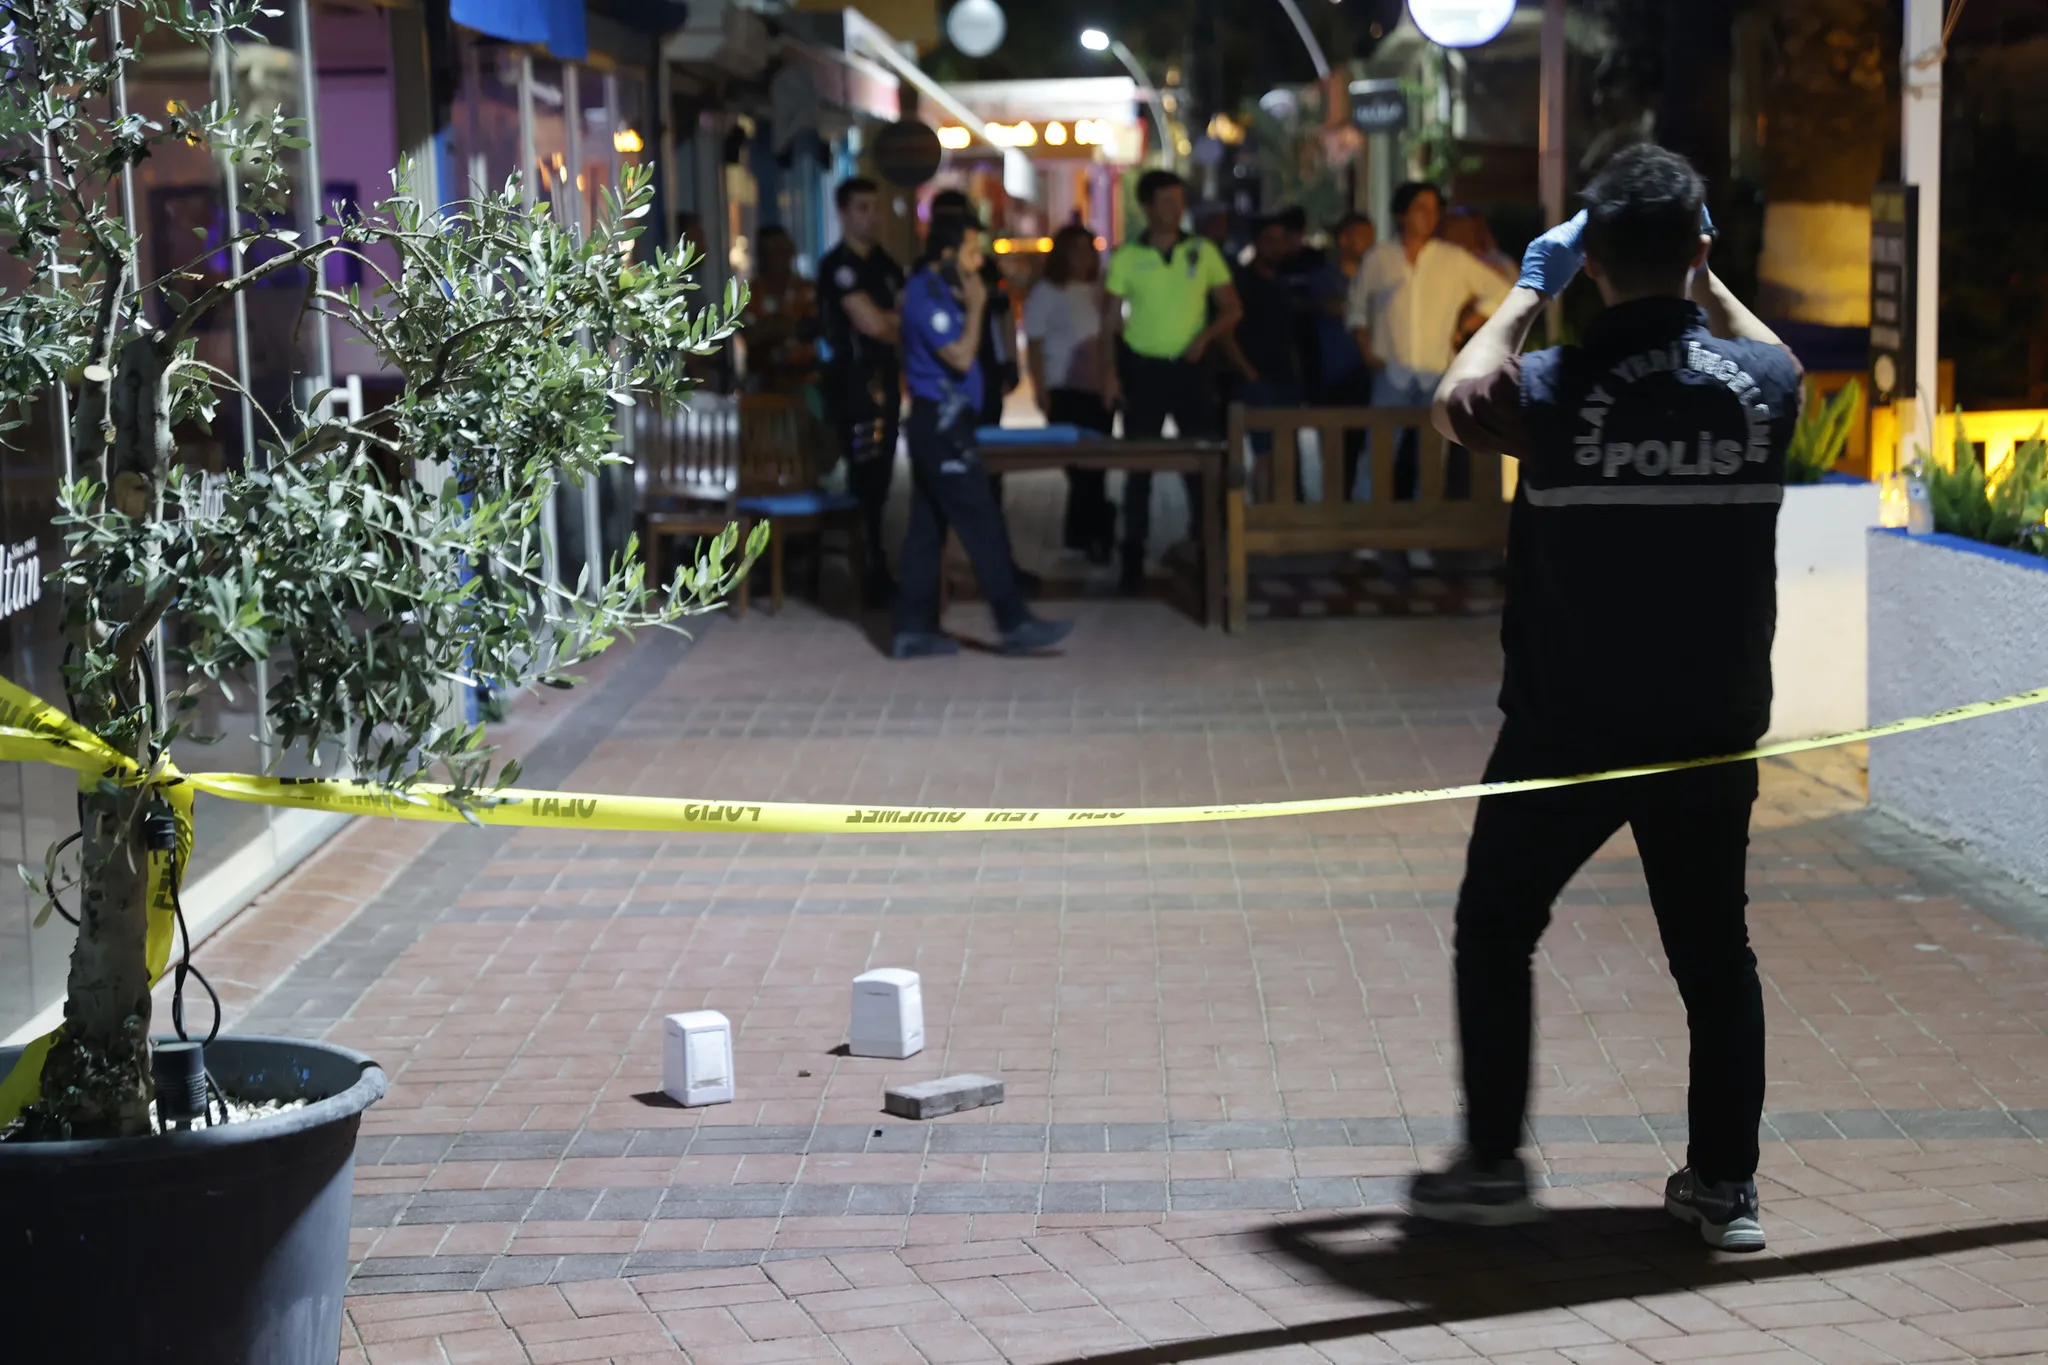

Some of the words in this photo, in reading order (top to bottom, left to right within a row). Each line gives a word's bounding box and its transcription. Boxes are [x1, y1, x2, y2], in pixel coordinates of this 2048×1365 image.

[1573, 384, 1616, 466] OLAY
[1609, 340, 1681, 383] YERİ
[1602, 431, 1744, 477] POLİS
